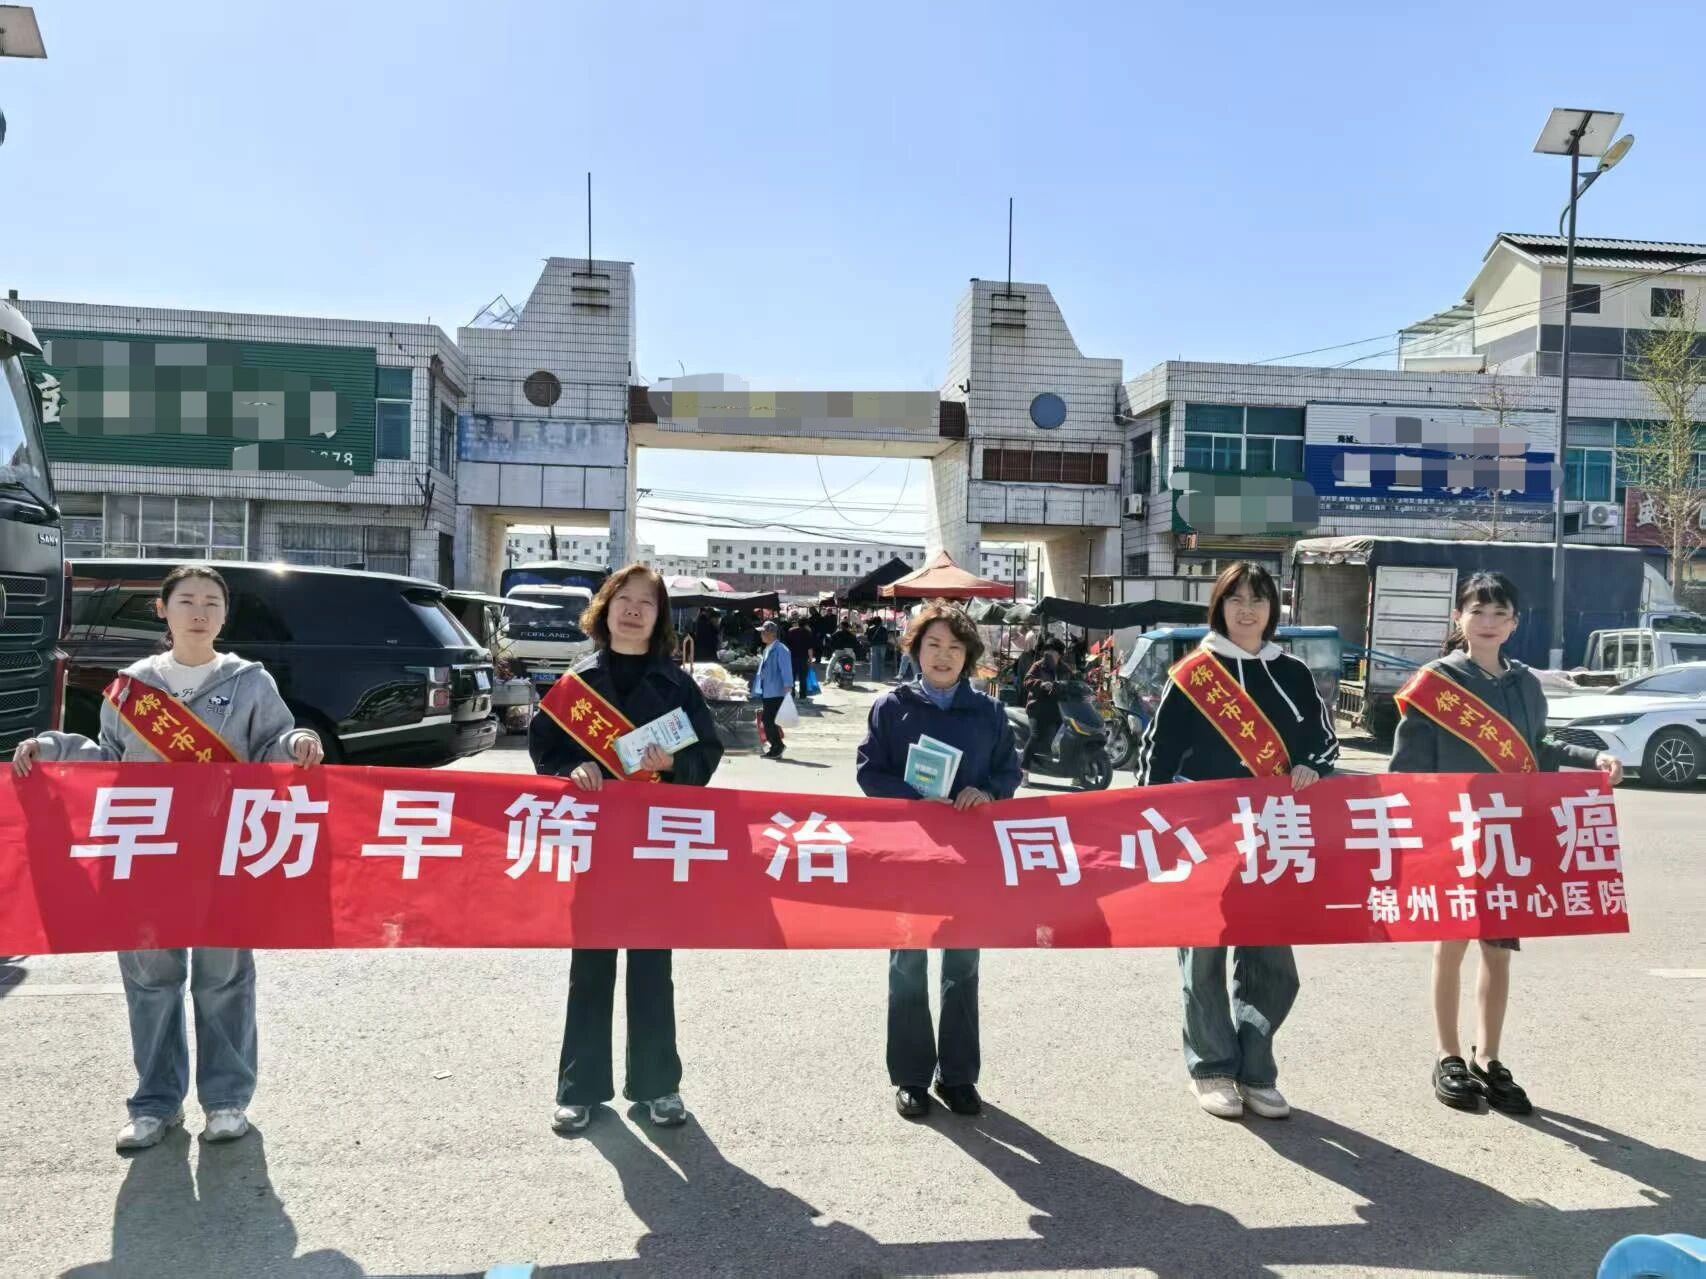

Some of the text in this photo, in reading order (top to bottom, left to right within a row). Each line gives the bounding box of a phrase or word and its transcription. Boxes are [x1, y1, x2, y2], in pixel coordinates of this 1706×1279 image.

[70, 785, 1623, 890] 早防早筛早治 同心携手抗癌
